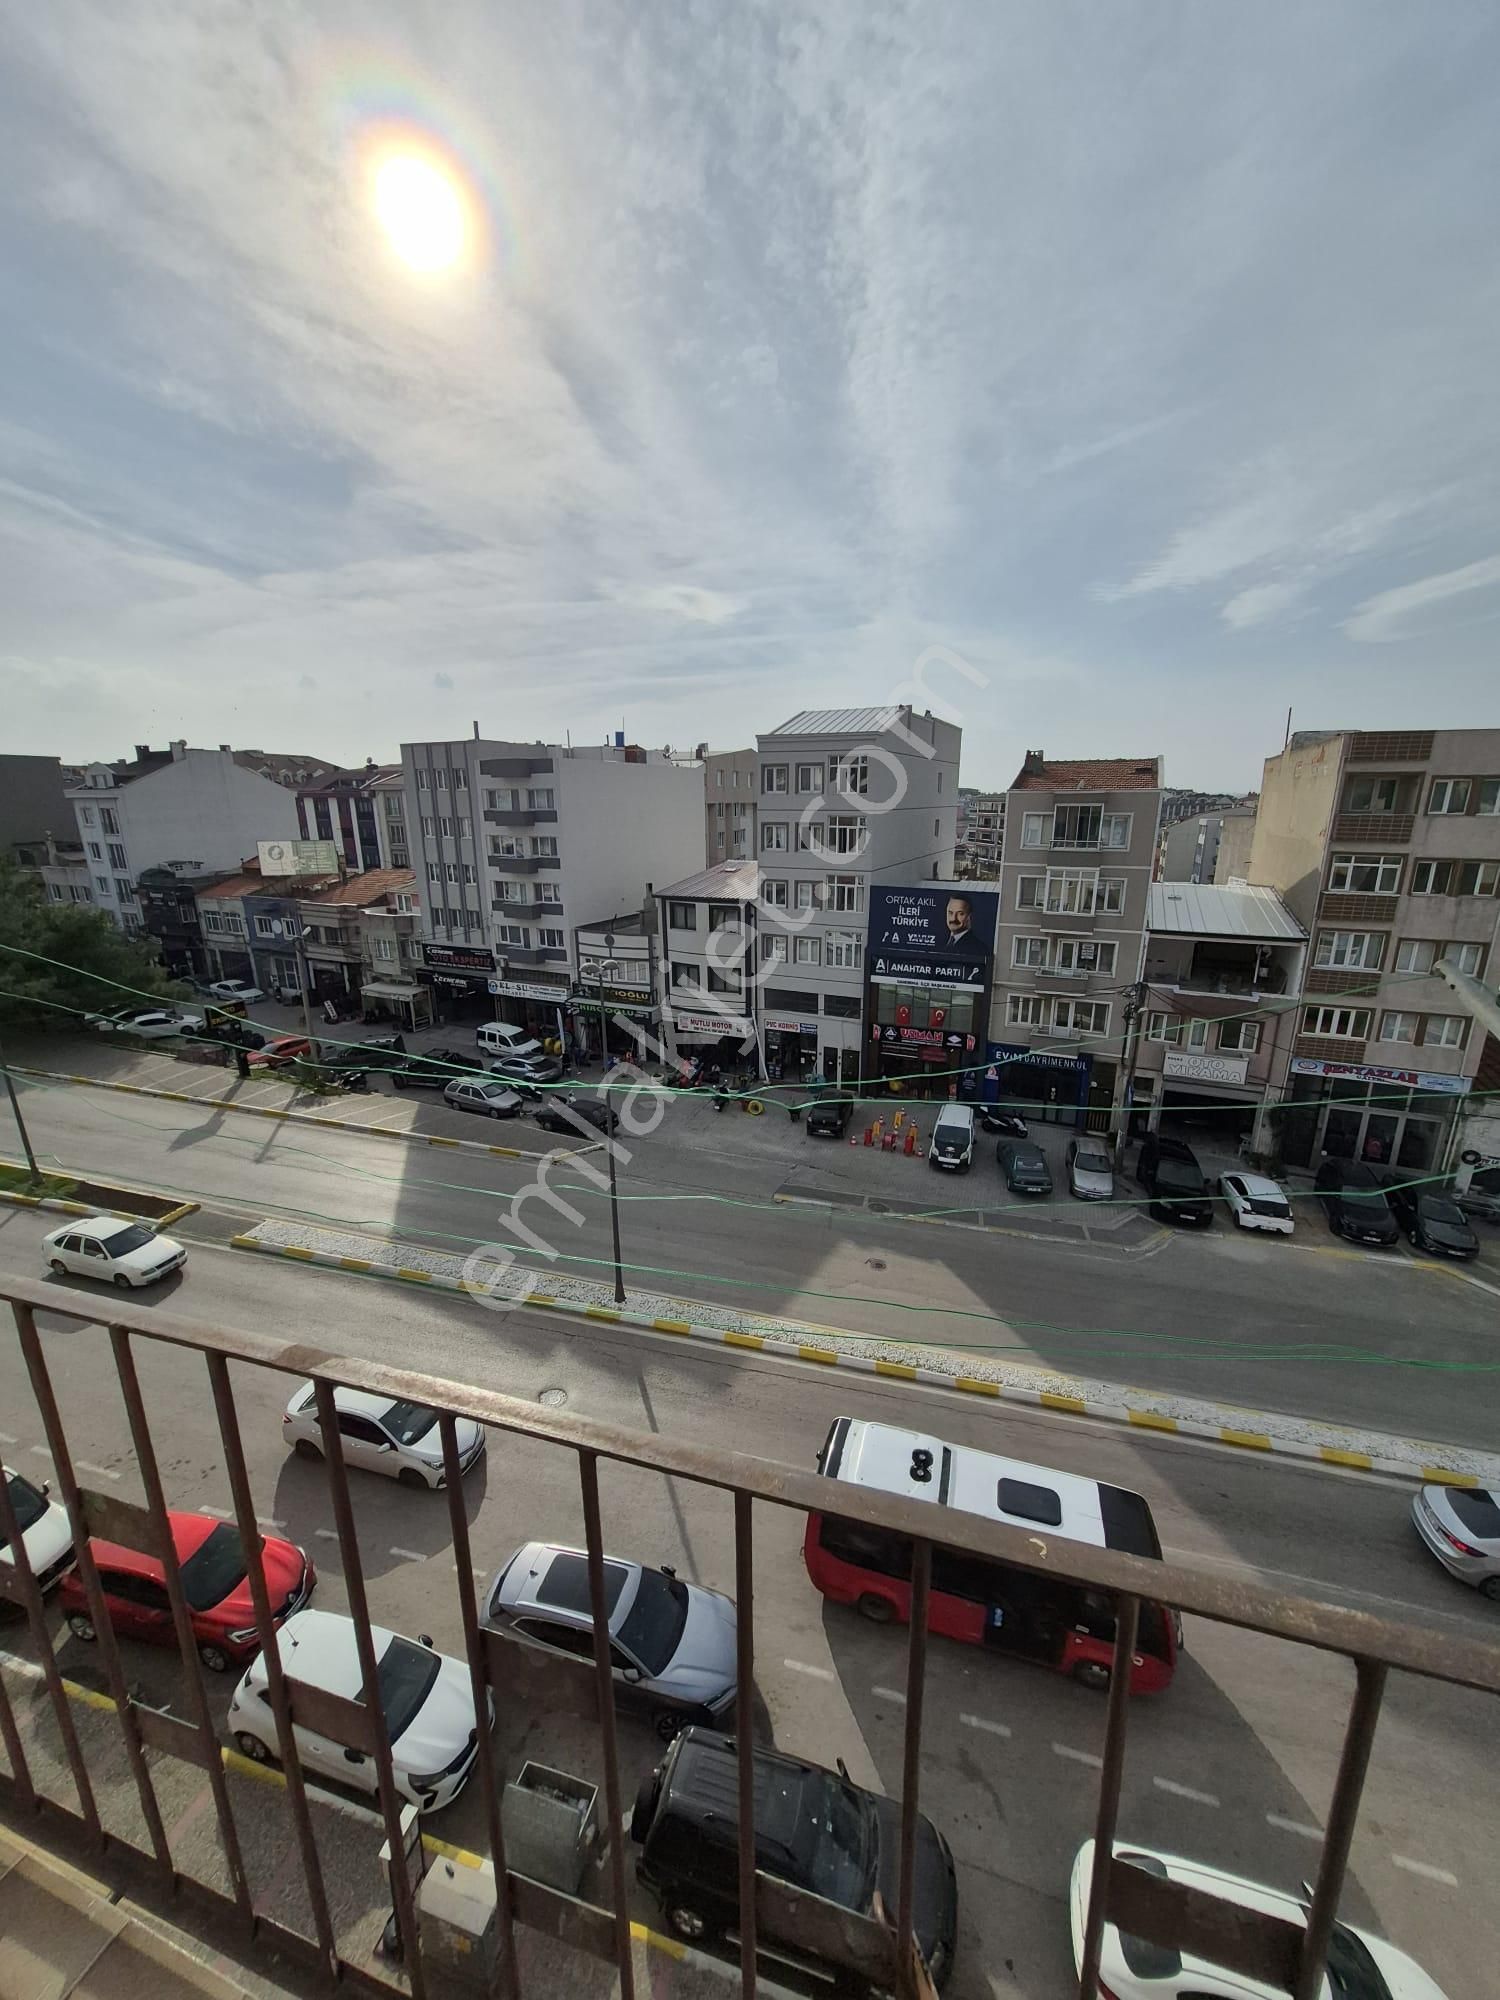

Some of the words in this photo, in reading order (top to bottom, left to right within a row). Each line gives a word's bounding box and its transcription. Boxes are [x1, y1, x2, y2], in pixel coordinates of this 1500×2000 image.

[885, 895, 915, 905] ORTAK
[917, 897, 937, 907] AKIL
[891, 915, 929, 928] TÜRKİYE
[890, 963, 931, 974] ANAHTAR
[690, 1018, 710, 1027] MUTLU
[711, 1022, 733, 1030] MOTOR
[1188, 1057, 1225, 1069] OTO
[1169, 1064, 1242, 1082] YIKAMA
[910, 1448, 934, 1484] 8
